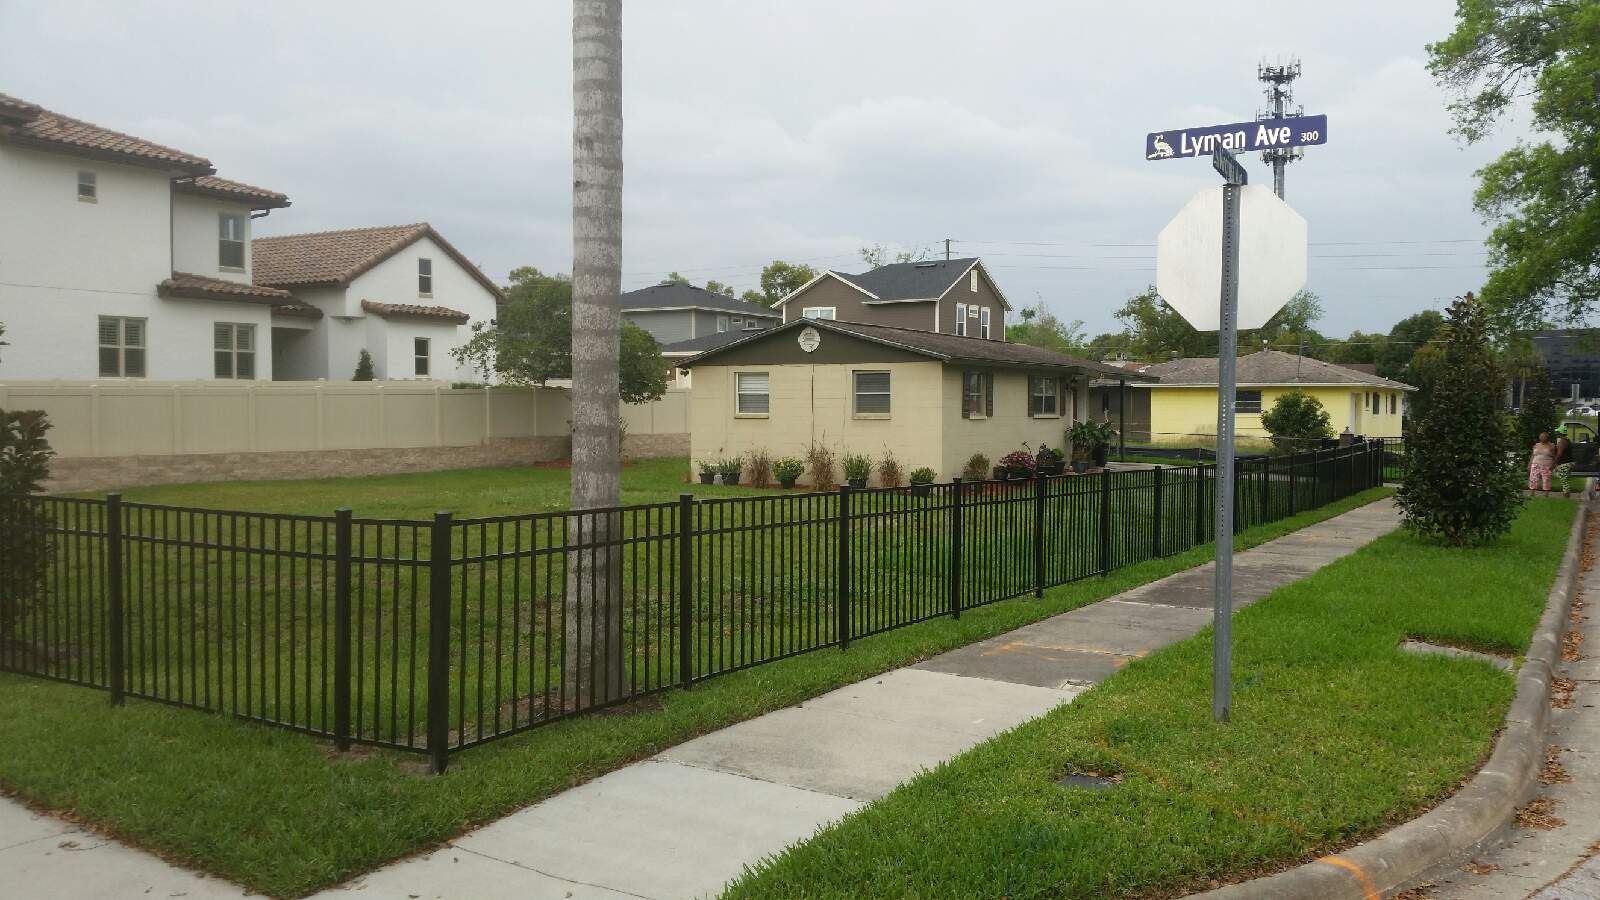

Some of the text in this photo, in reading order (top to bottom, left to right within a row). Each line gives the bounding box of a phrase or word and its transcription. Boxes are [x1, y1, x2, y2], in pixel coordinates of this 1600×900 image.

[1180, 125, 1319, 157] Lyman Ave 300
